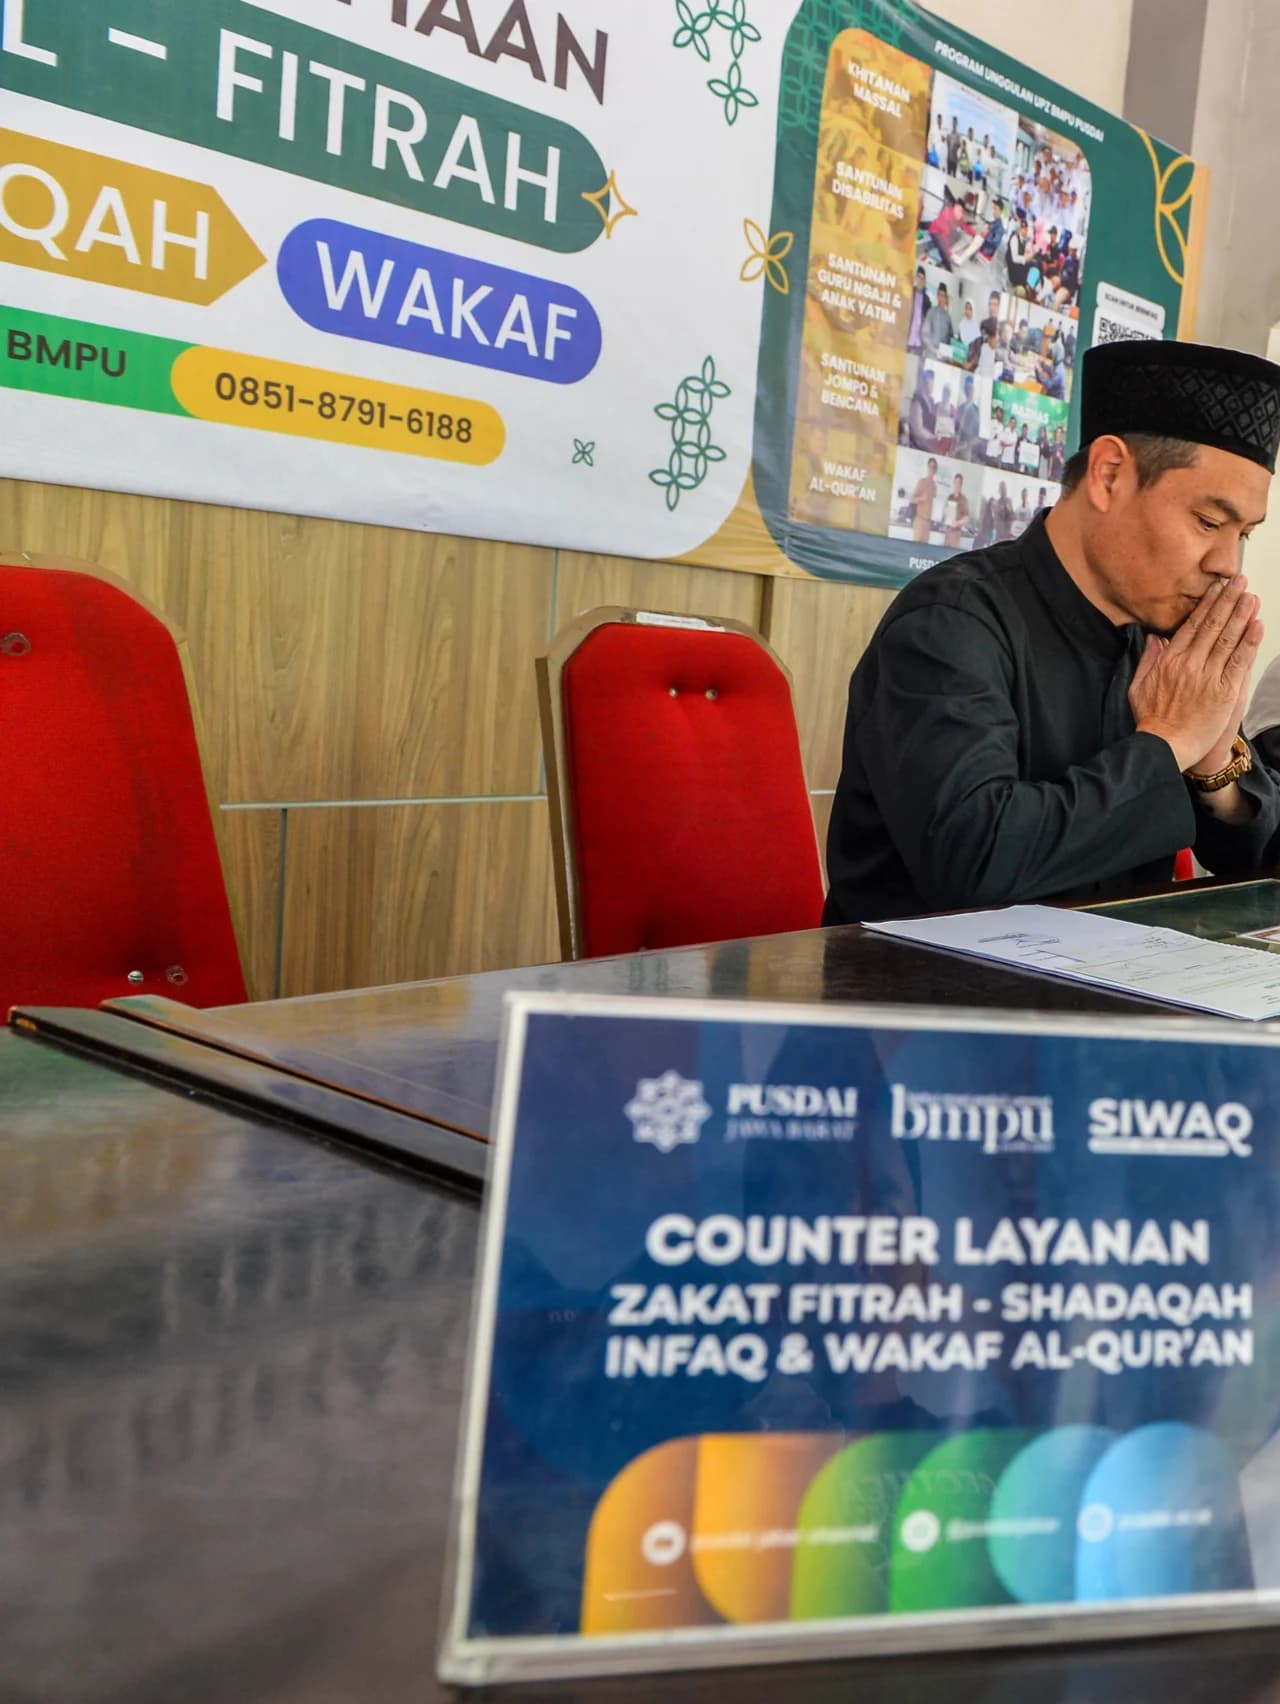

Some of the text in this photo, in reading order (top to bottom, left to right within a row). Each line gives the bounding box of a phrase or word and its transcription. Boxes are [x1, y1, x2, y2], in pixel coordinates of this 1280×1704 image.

[334, 0, 608, 105] AAN
[934, 39, 985, 77] PROGRAM
[984, 66, 1034, 104] UNGGULAN
[848, 60, 911, 103] KHITANAN
[853, 84, 903, 118] MASSAL
[216, 28, 560, 224] FITRAH
[832, 178, 905, 219] DISABILITAS
[836, 161, 903, 201] SANTUNAN
[0, 162, 209, 280] QAH
[817, 268, 854, 292] GURU
[853, 278, 892, 305] NGAJI
[828, 252, 897, 288] SANTUNAN
[316, 240, 578, 362] WAKAF
[821, 289, 897, 325] ANAK YATIM
[6, 329, 127, 378] BMPU
[820, 352, 886, 383] SANTUNAN
[821, 389, 880, 416] BENCANA
[824, 373, 868, 396] JOMPO
[214, 371, 473, 445] 0851-8791-6188
[809, 476, 877, 501] AL-QUR'AN
[823, 462, 868, 482] WAKAF
[727, 1083, 858, 1118] PUSDAI
[891, 1083, 1054, 1154] bmpu
[1088, 1097, 1253, 1157] SIWAQ
[646, 1214, 1210, 1266] COUNTER LAYANAN
[608, 1282, 1253, 1326] ZAKAT FITRAH - SHADAQAH
[605, 1328, 1253, 1382] INFAQ & WAKAF AL-QUR'AN
